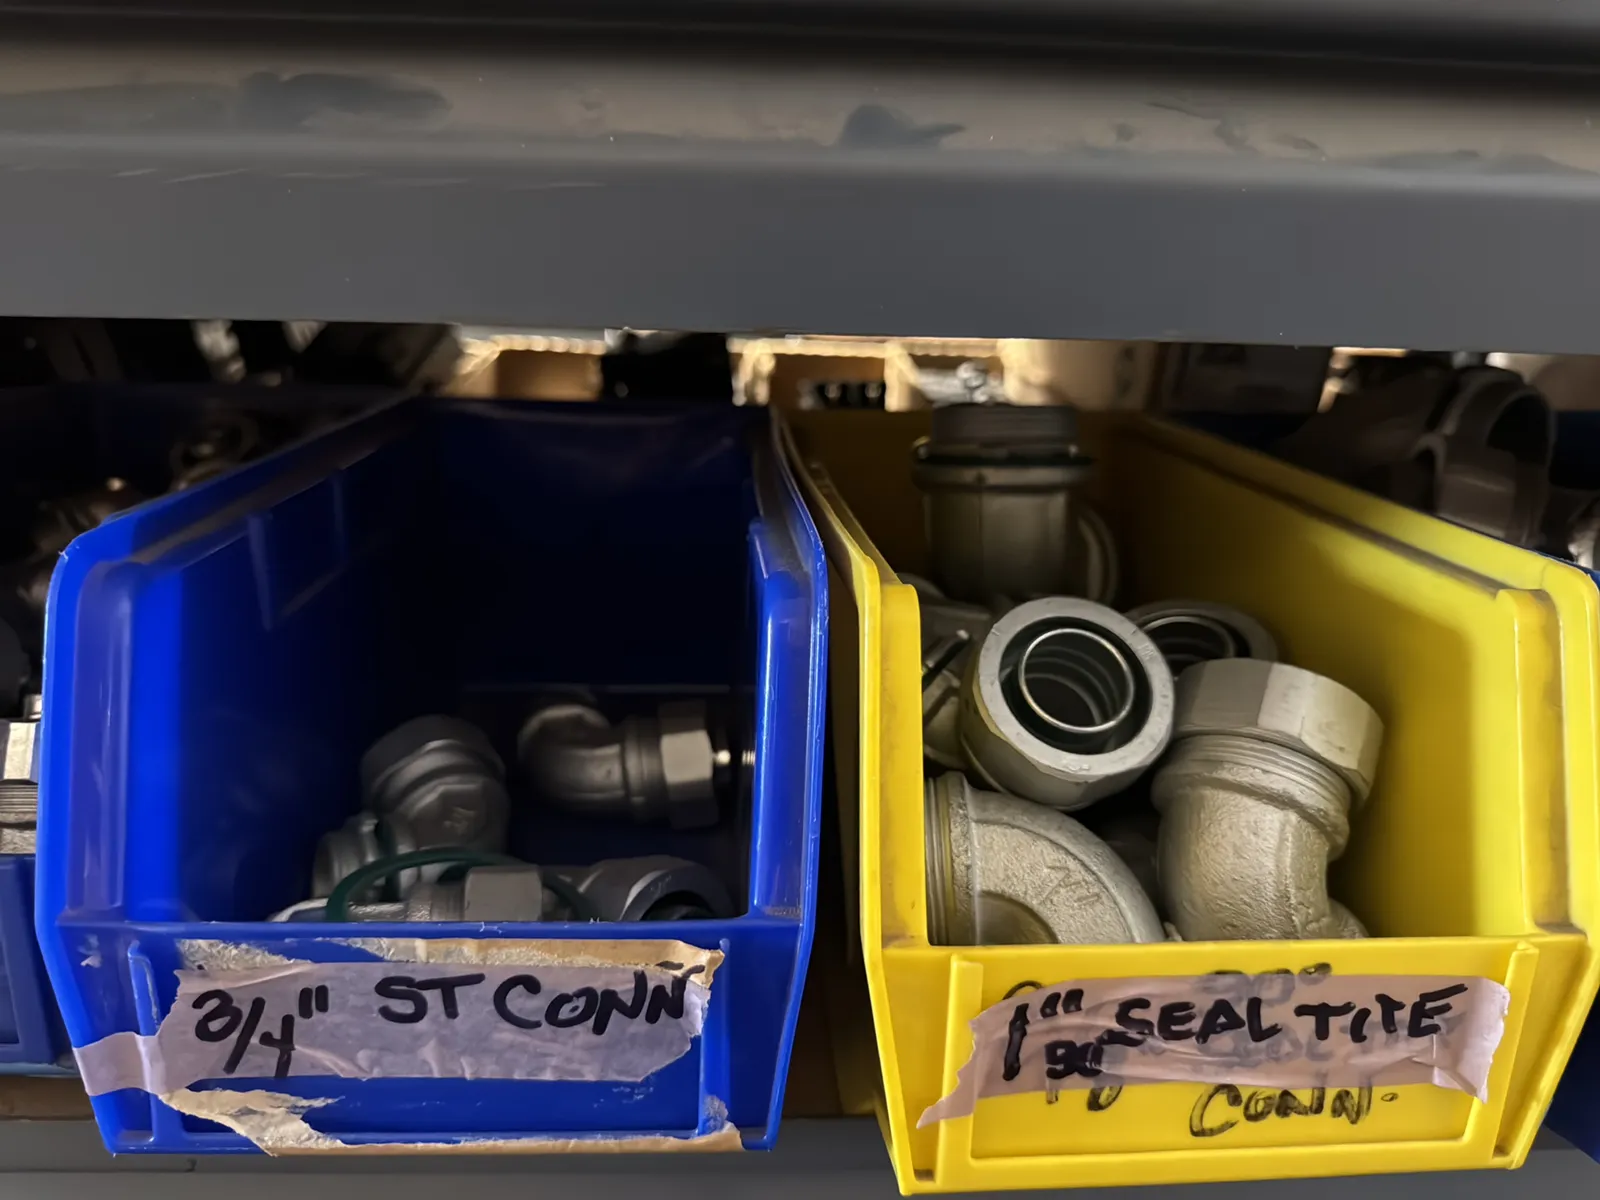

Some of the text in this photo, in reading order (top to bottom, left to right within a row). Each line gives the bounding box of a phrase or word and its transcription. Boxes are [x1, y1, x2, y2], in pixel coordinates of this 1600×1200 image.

[192, 965, 704, 1078] 3/4" ST CONN
[1003, 988, 1084, 1081] 1"
[1115, 997, 1282, 1046] SEAL
[1294, 983, 1469, 1042] TITE
